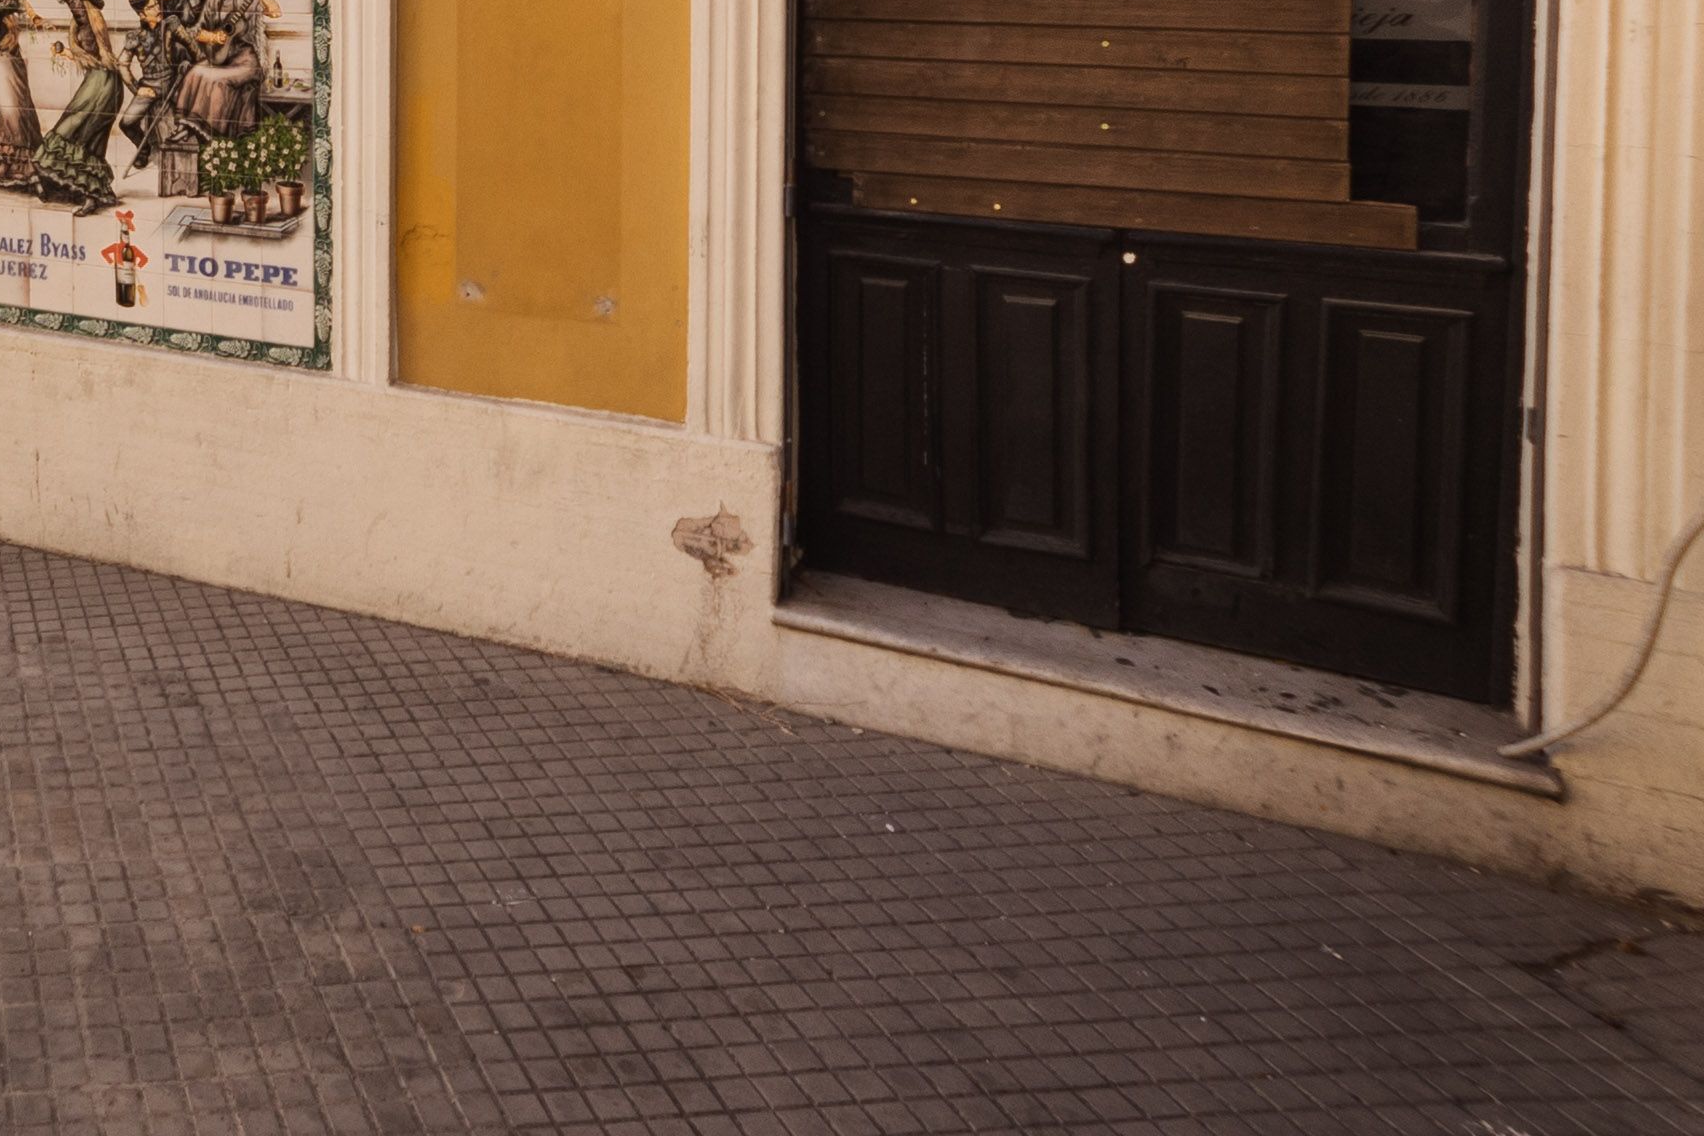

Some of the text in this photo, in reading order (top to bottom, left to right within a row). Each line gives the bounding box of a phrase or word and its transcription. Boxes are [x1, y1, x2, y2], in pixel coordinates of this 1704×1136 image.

[40, 233, 86, 261] BYASS
[164, 253, 219, 278] TIO
[224, 260, 298, 287] PEPE
[167, 285, 180, 297] SOL
[183, 286, 192, 299] DE
[238, 294, 294, 312] EMBOTELLADO
